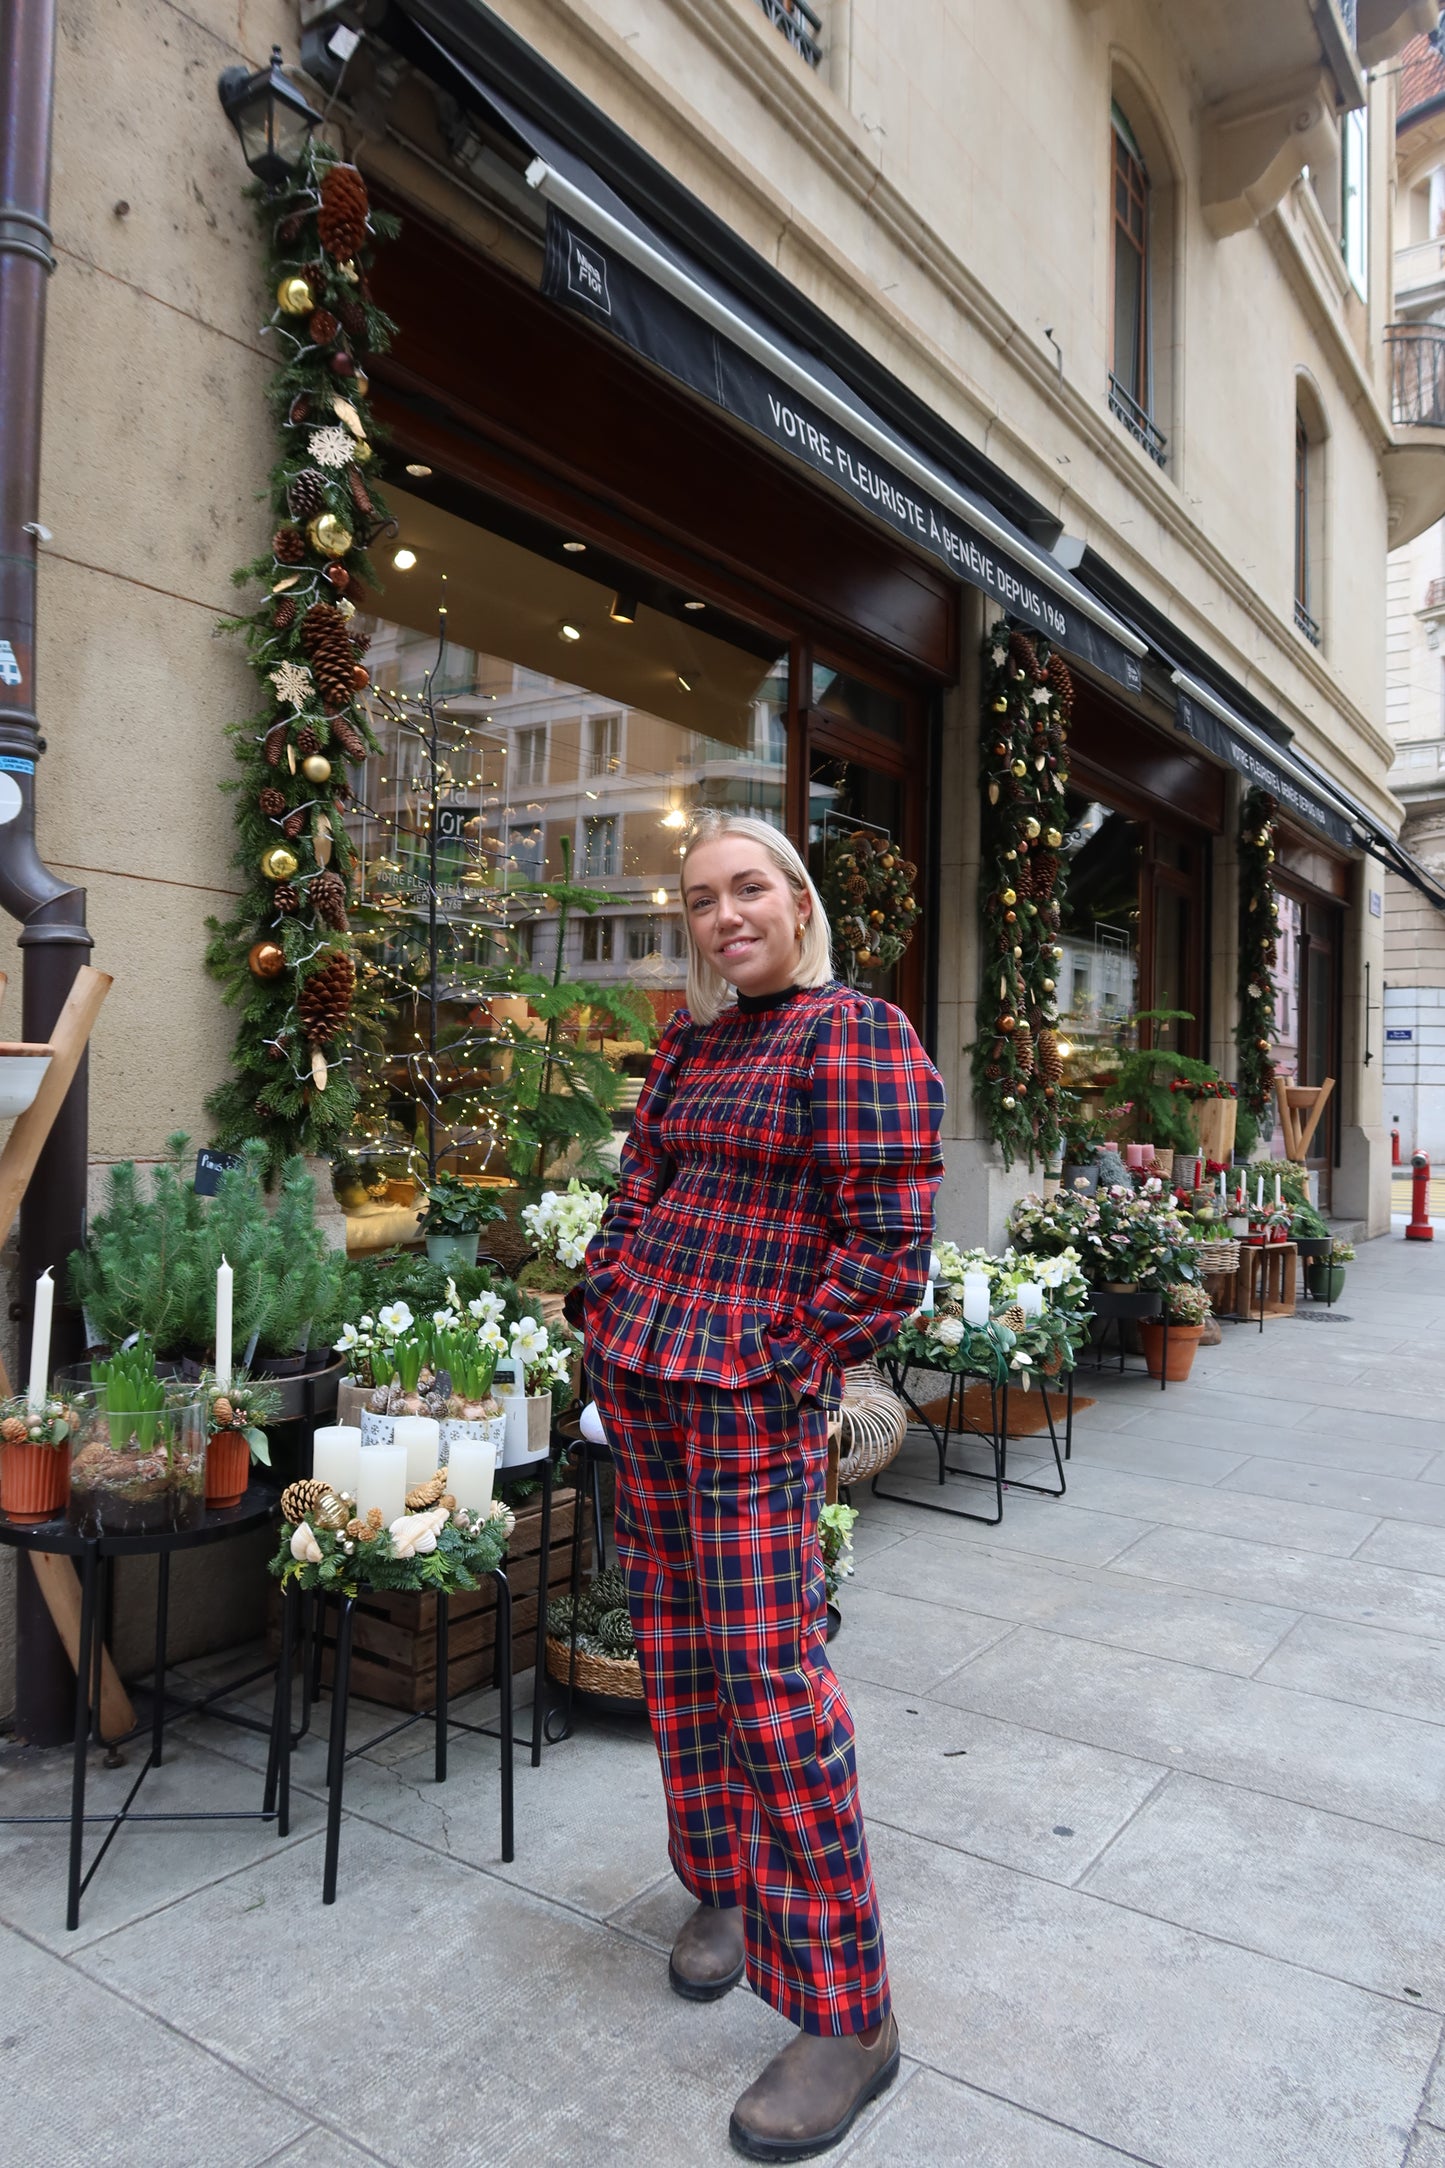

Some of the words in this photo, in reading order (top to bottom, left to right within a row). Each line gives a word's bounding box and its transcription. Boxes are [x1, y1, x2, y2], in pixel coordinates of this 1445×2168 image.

[576, 248, 601, 282] Mina
[578, 266, 602, 295] Flor
[767, 393, 834, 466] VOTRE
[836, 445, 927, 533] FLEURISTE
[930, 508, 941, 543] À
[942, 526, 995, 585] GENÈVE
[996, 566, 1041, 617] DEPUIS
[1042, 601, 1066, 636] 1968
[412, 764, 468, 805] Mna
[416, 798, 465, 836] Flor
[376, 871, 406, 886] VOTRE
[407, 876, 453, 892] FLEUSTE
